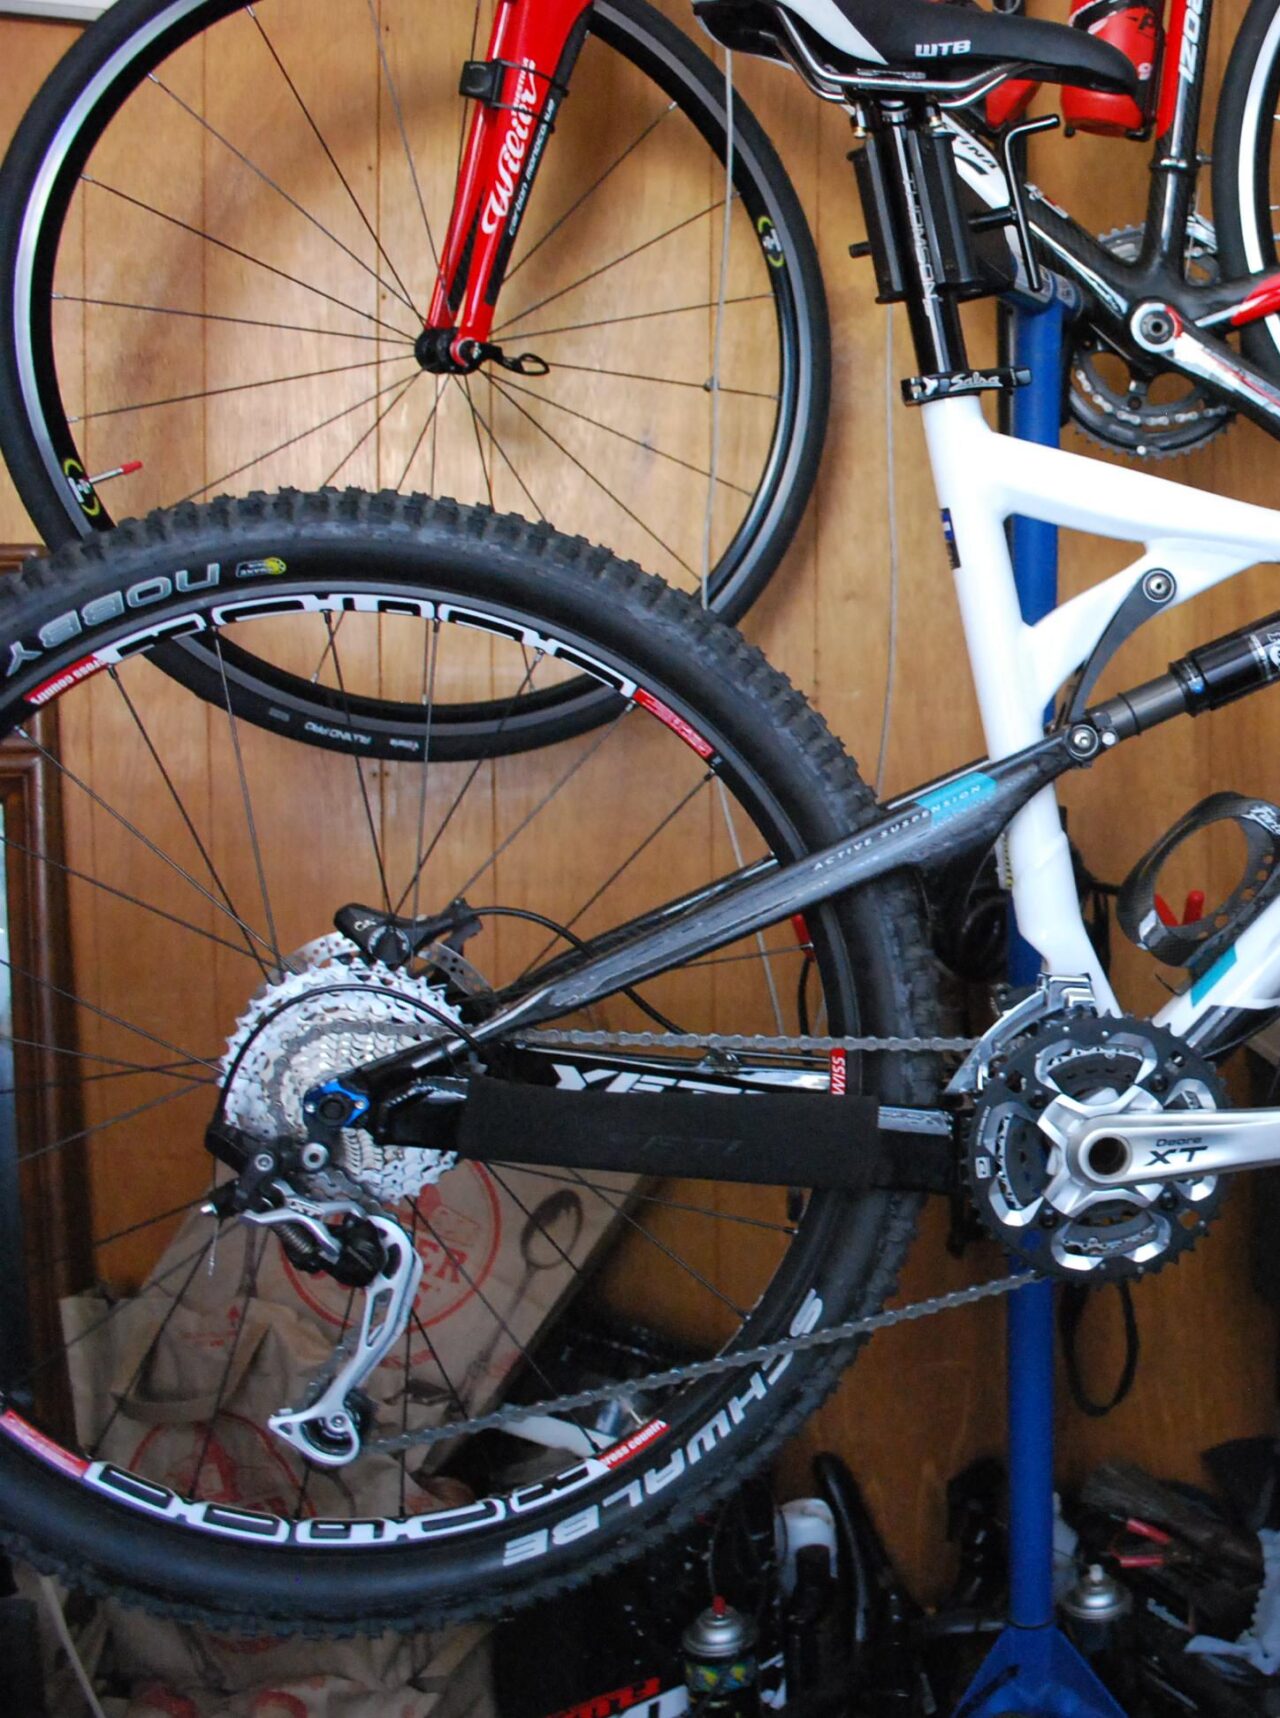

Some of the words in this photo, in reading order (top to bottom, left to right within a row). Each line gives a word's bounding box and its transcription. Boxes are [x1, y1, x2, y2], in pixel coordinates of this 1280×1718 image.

[915, 40, 971, 57] WTB
[481, 60, 537, 235] Wilier
[509, 182, 528, 236] carbon
[525, 98, 556, 180] monocoue
[949, 372, 1004, 392] Salsa
[813, 838, 873, 871] ACTIVE
[880, 784, 982, 838] SUSPENSION
[830, 1056, 846, 1096] WISS
[1144, 1147, 1208, 1167] XT
[1156, 1136, 1202, 1147] Deore
[502, 1288, 823, 1566] SCHWALBE
